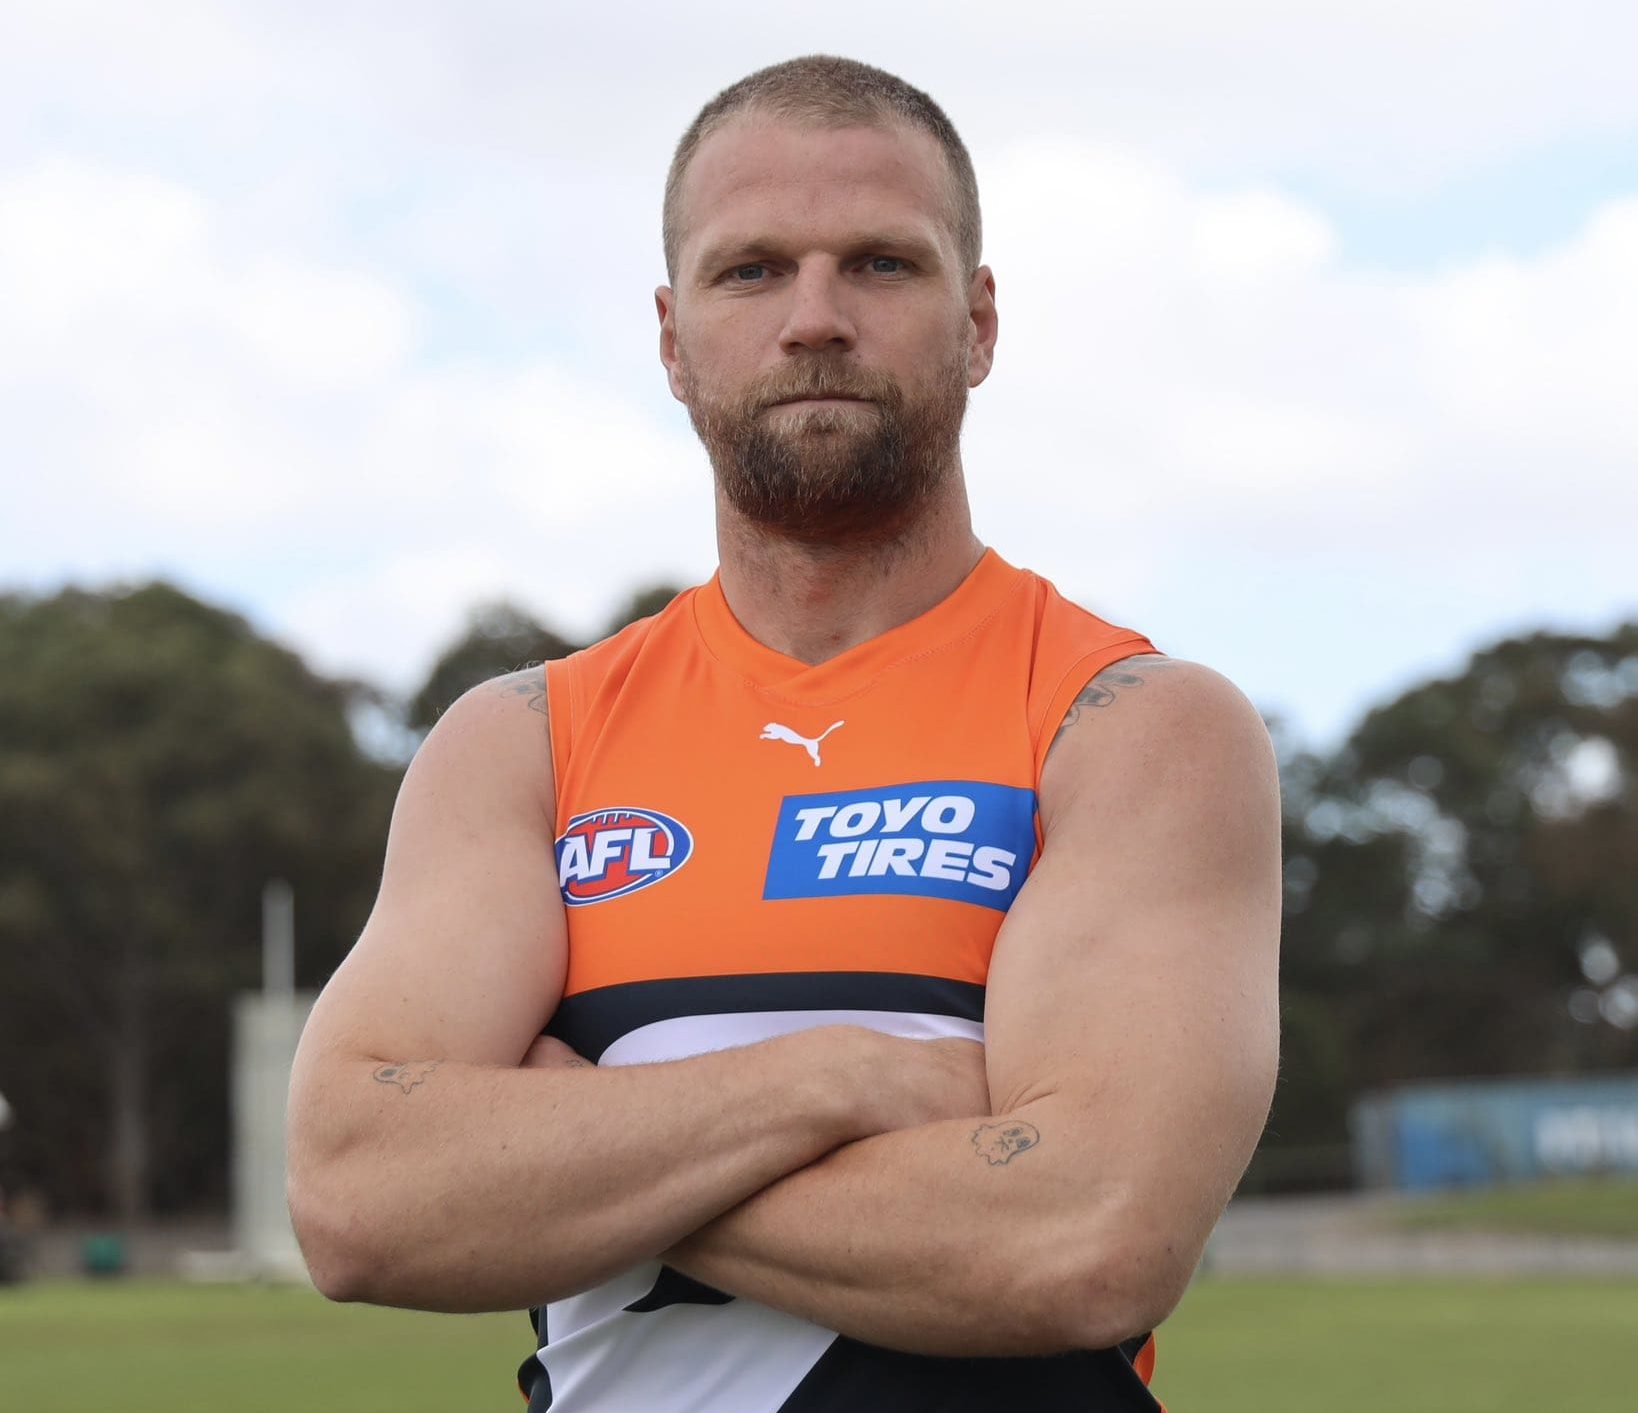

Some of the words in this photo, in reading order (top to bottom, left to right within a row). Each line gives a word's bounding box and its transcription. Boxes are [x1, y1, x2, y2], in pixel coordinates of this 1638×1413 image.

[795, 796, 975, 841] TOYO
[560, 828, 671, 886] AFL
[818, 839, 1016, 891] TIRES
